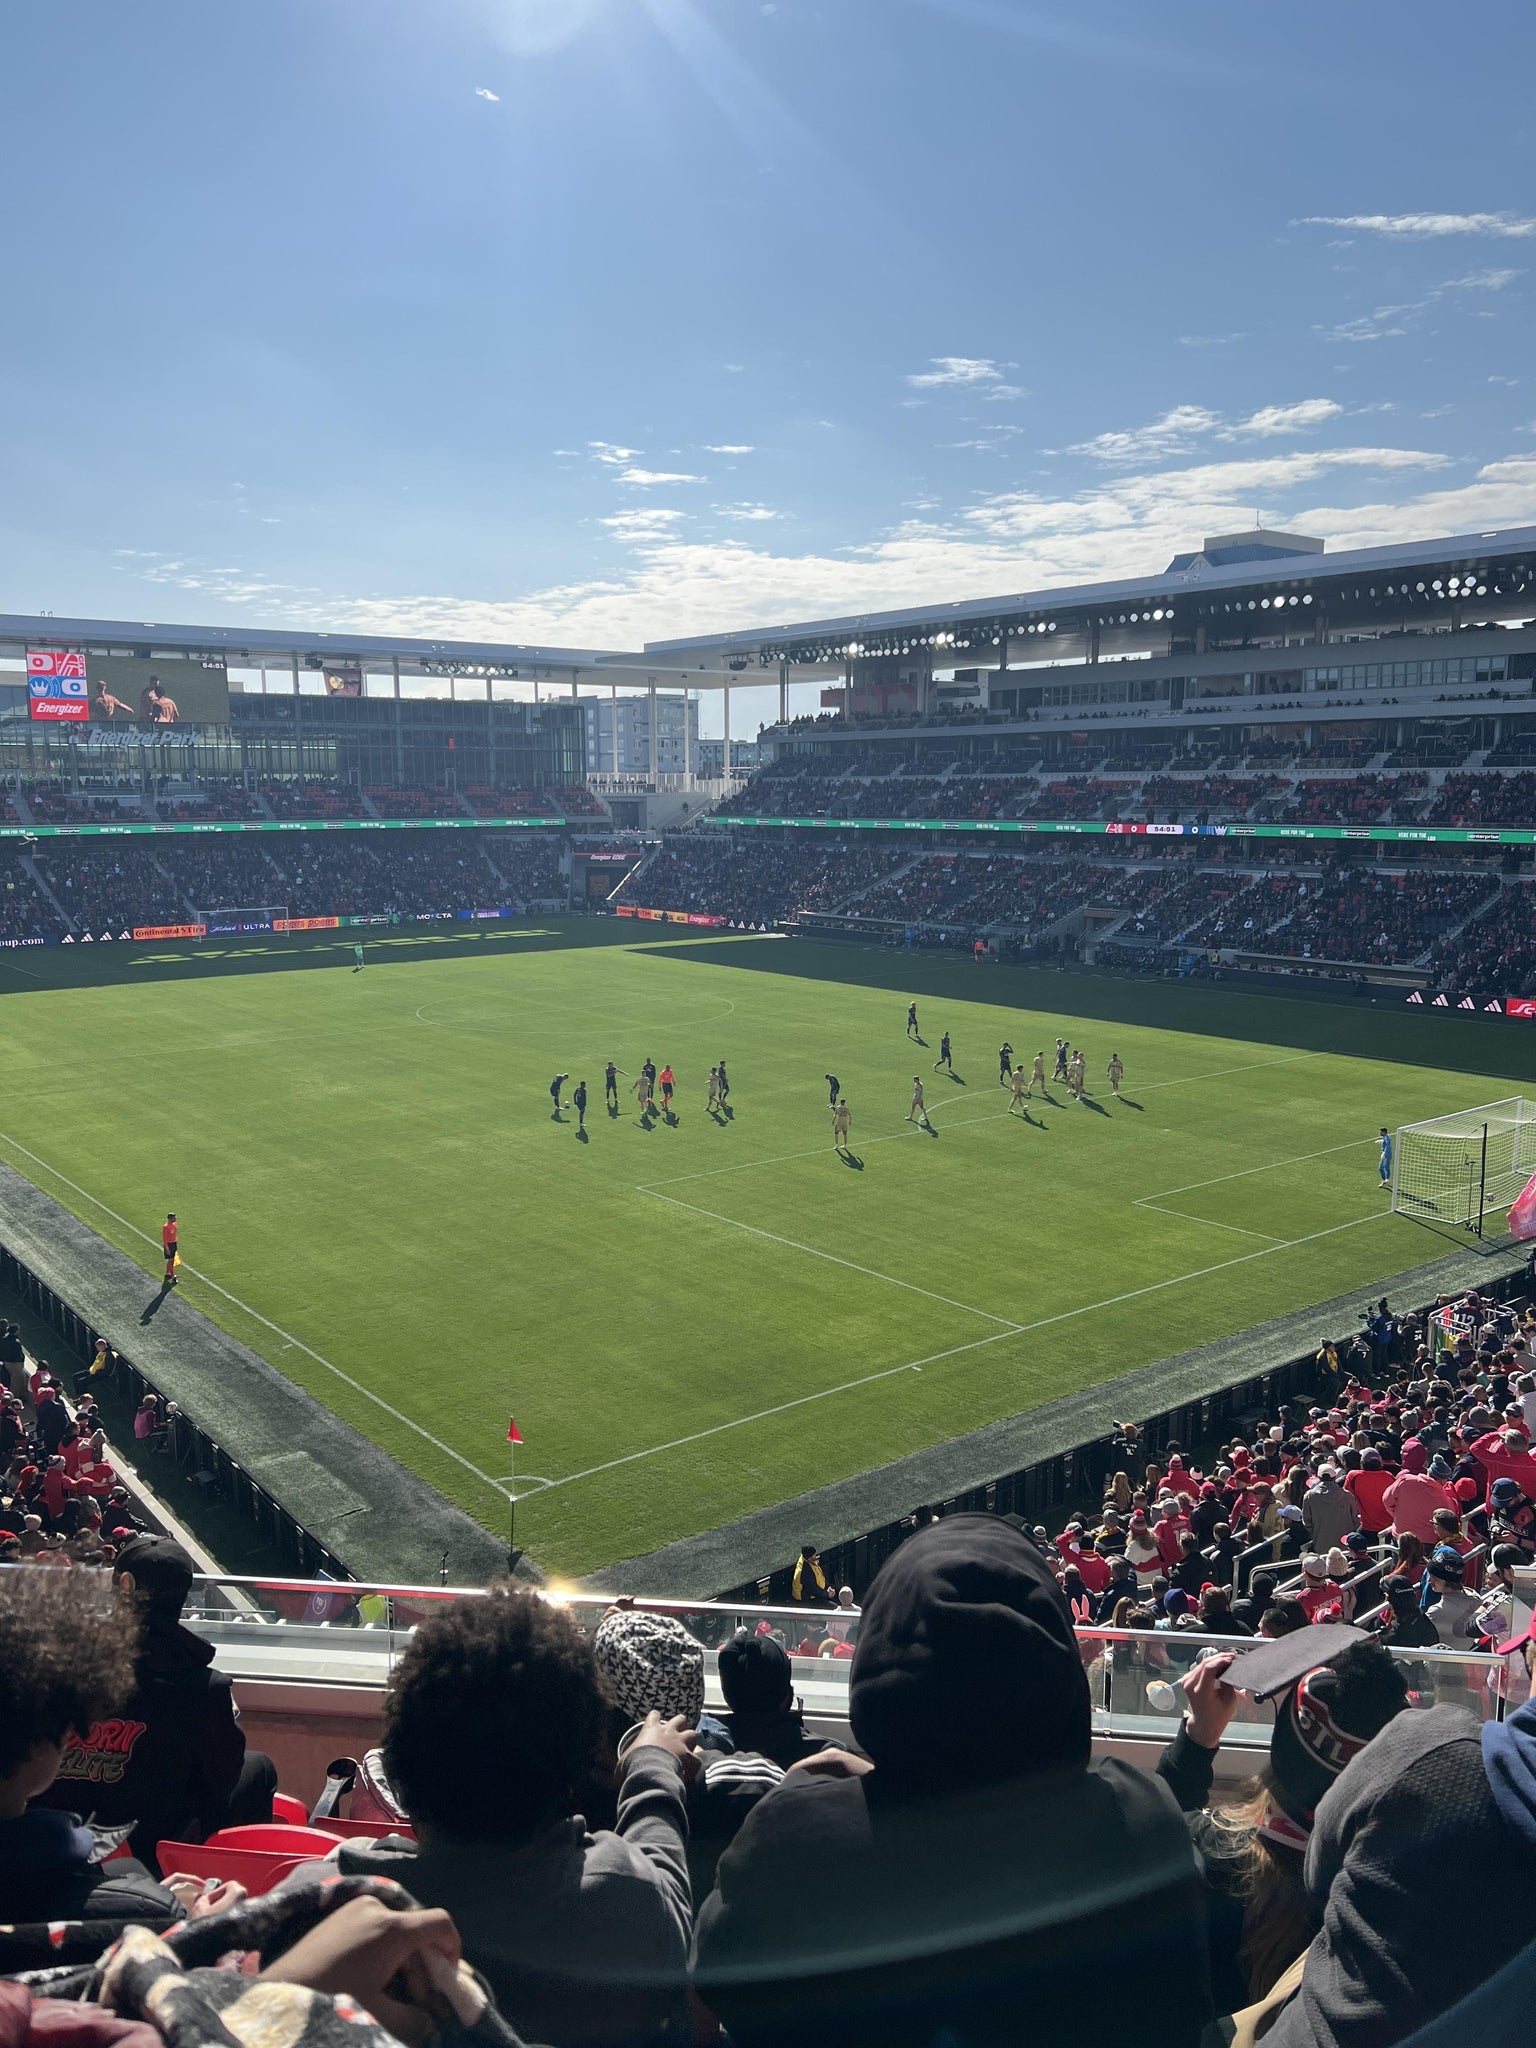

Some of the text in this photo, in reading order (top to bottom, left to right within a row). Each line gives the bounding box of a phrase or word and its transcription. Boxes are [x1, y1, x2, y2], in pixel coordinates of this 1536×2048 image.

[36, 702, 83, 715] Energizer
[88, 729, 200, 748] Energizer Park
[136, 926, 178, 938] Continental
